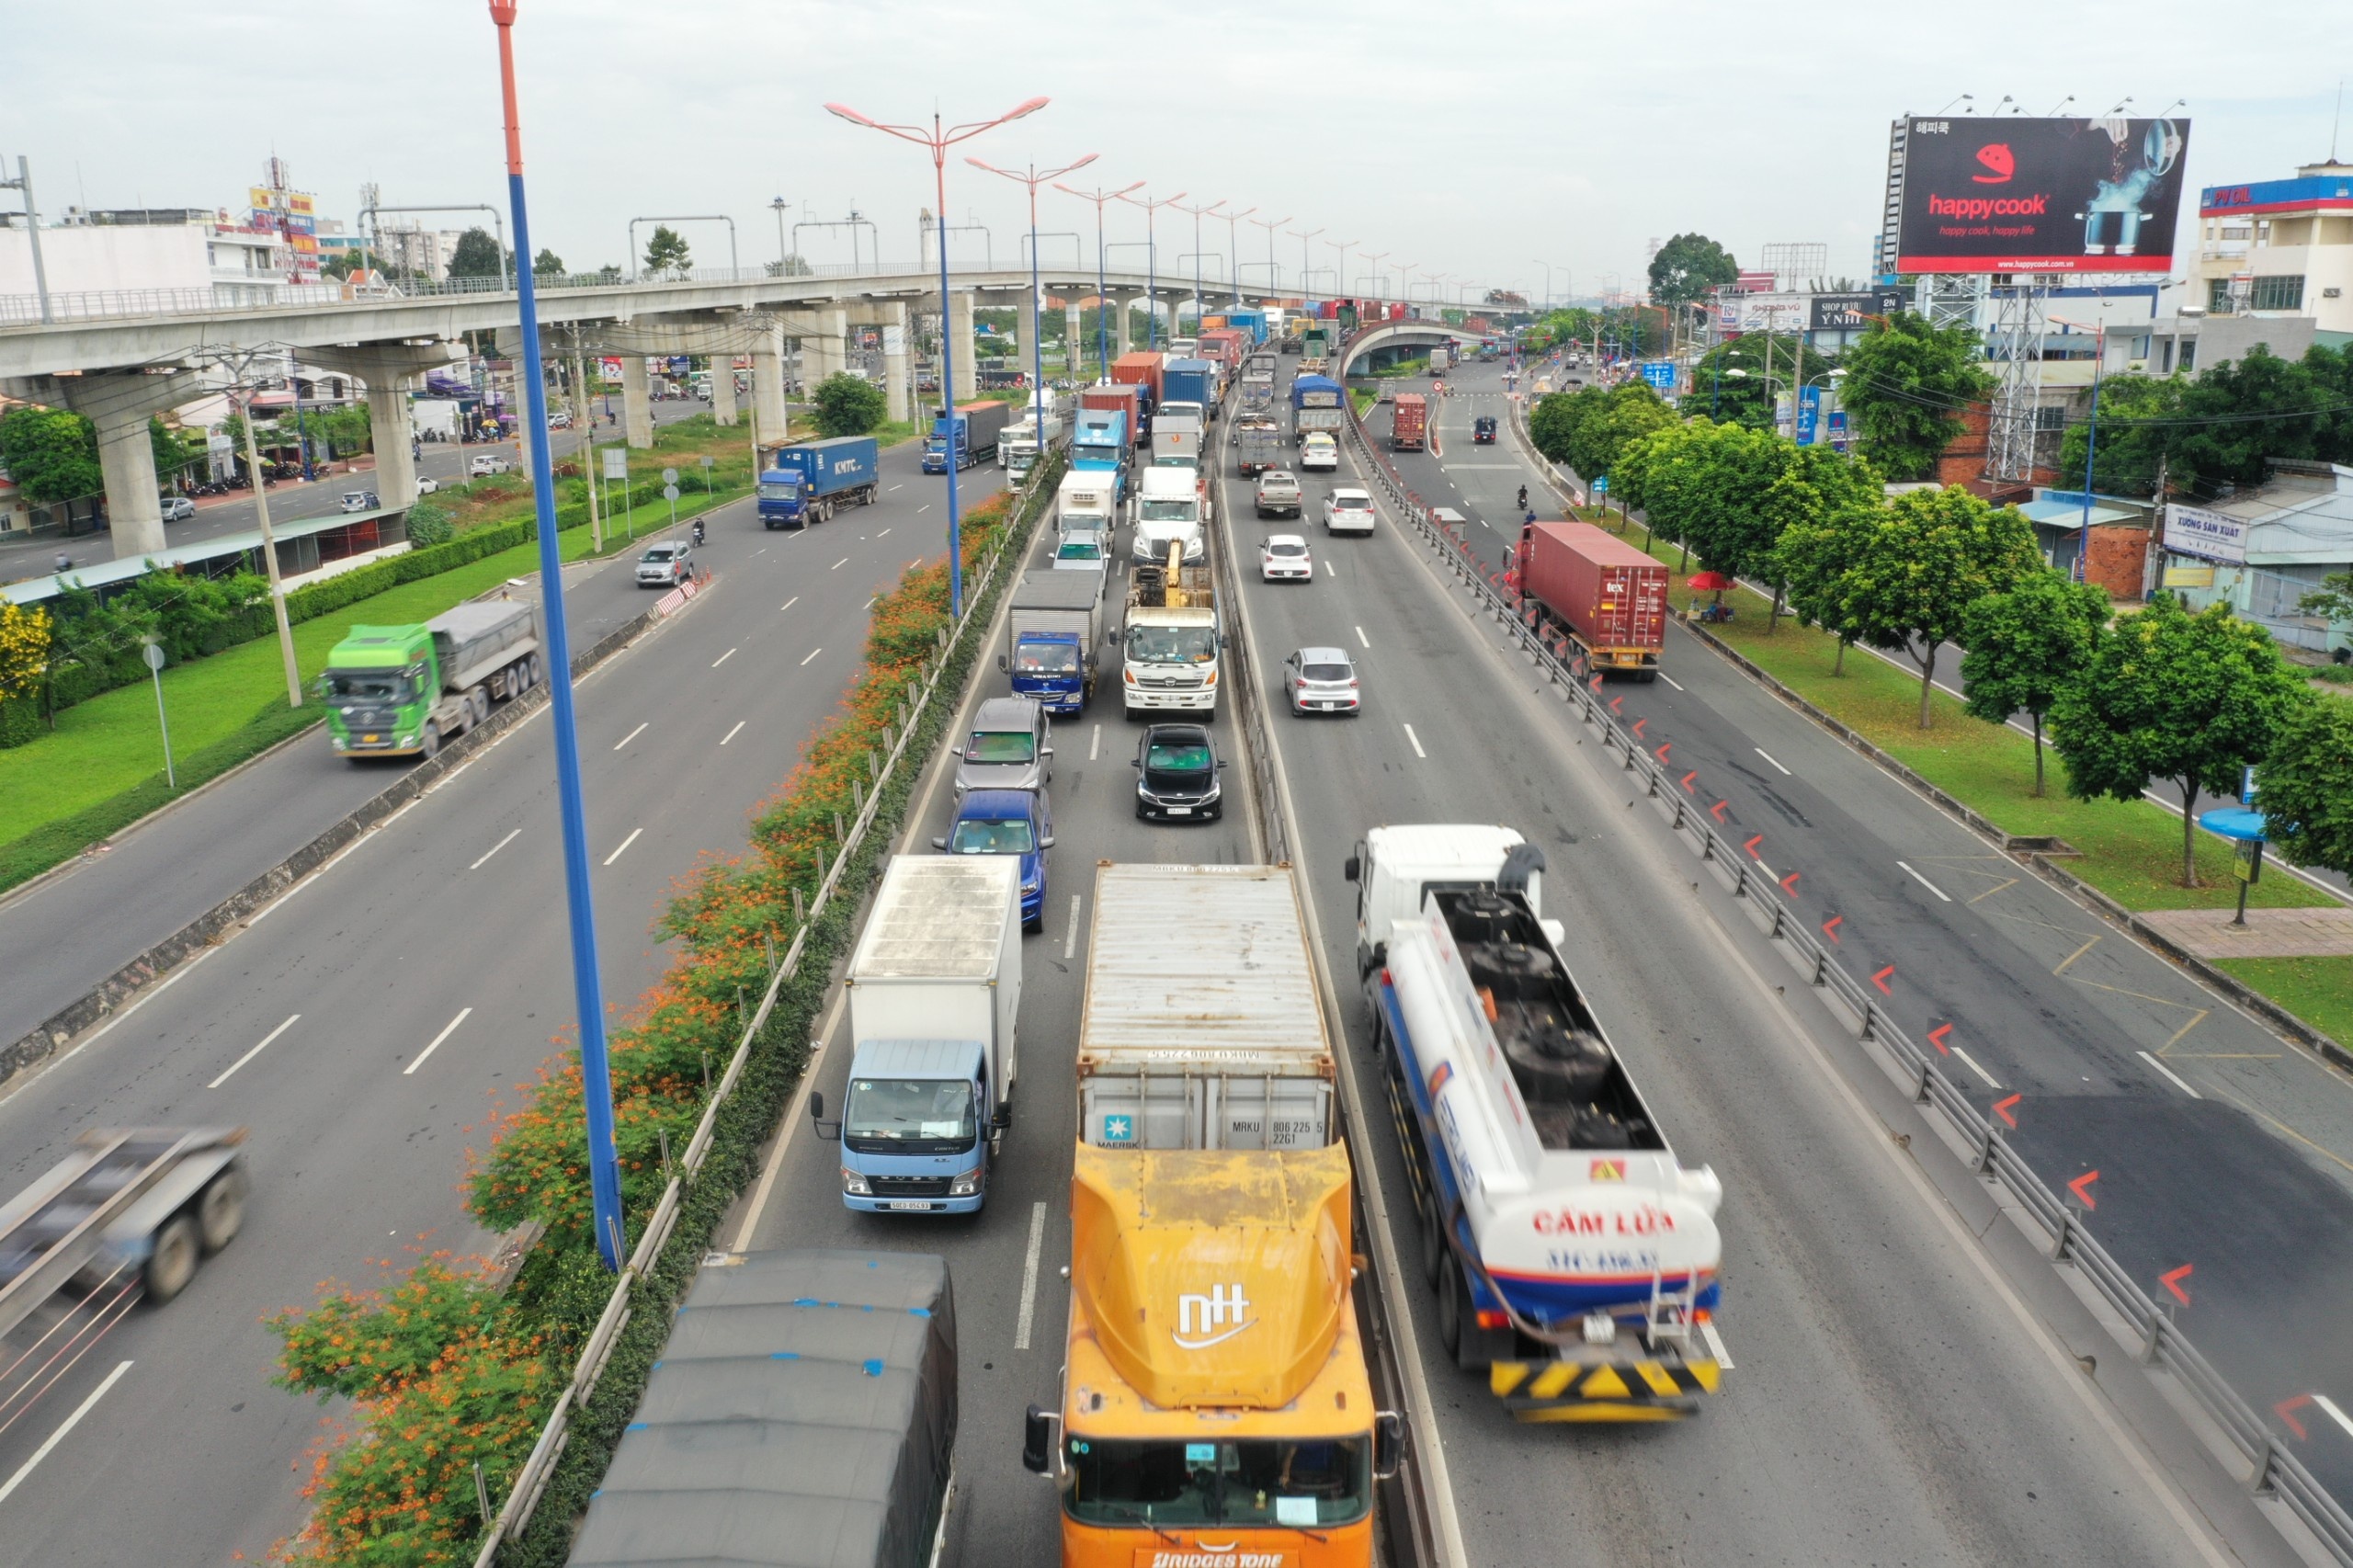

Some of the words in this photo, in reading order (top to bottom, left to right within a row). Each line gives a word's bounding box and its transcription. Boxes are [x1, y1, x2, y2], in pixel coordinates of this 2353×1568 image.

[1915, 121, 1949, 134] 해피쿡
[2213, 188, 2232, 204] PV
[2233, 187, 2251, 203] OIL
[1928, 193, 2045, 220] happycook
[1938, 225, 1968, 237] happy
[1968, 225, 1991, 236] cook,
[1992, 225, 2020, 237] happy
[2020, 225, 2035, 235] life
[1997, 260, 2075, 269] www.happycook.com.vn
[1821, 302, 1839, 312] SHOP
[1882, 298, 1896, 307] 2N
[834, 458, 857, 475] KMTC
[1233, 1121, 1260, 1133] MRKU
[1273, 1121, 1290, 1133] 806
[1293, 1121, 1311, 1133] 225
[1316, 1121, 1324, 1133] 5
[1273, 1133, 1296, 1144] 22G1
